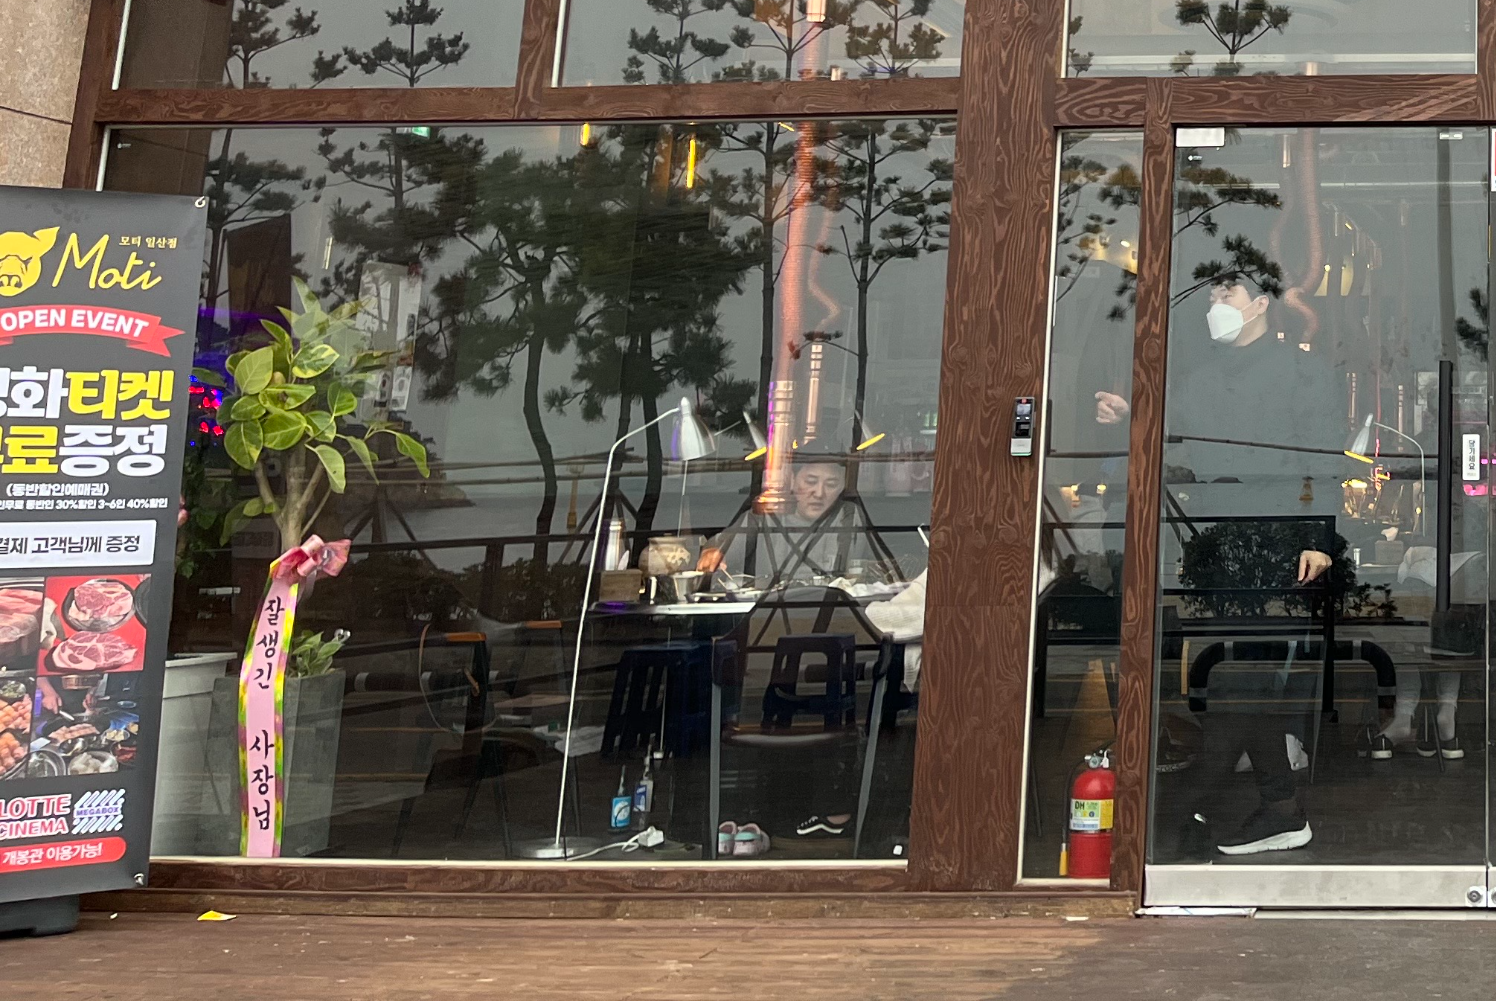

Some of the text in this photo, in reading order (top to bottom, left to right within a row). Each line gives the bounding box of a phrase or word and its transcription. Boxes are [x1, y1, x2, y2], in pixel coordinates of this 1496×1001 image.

[118, 235, 178, 249] 모티 일산점
[51, 232, 163, 291] Moti
[0, 308, 149, 338] OPEN EVENT
[0, 424, 168, 477] 료증정
[31, 536, 103, 554] 고객님께
[106, 535, 141, 553] 증정
[249, 595, 285, 831] 잘생긴 사장님
[0, 794, 72, 820] LOTTE
[75, 806, 120, 817] MEGABOX
[0, 817, 69, 840] CINEMA
[2, 847, 44, 866] 개봉관
